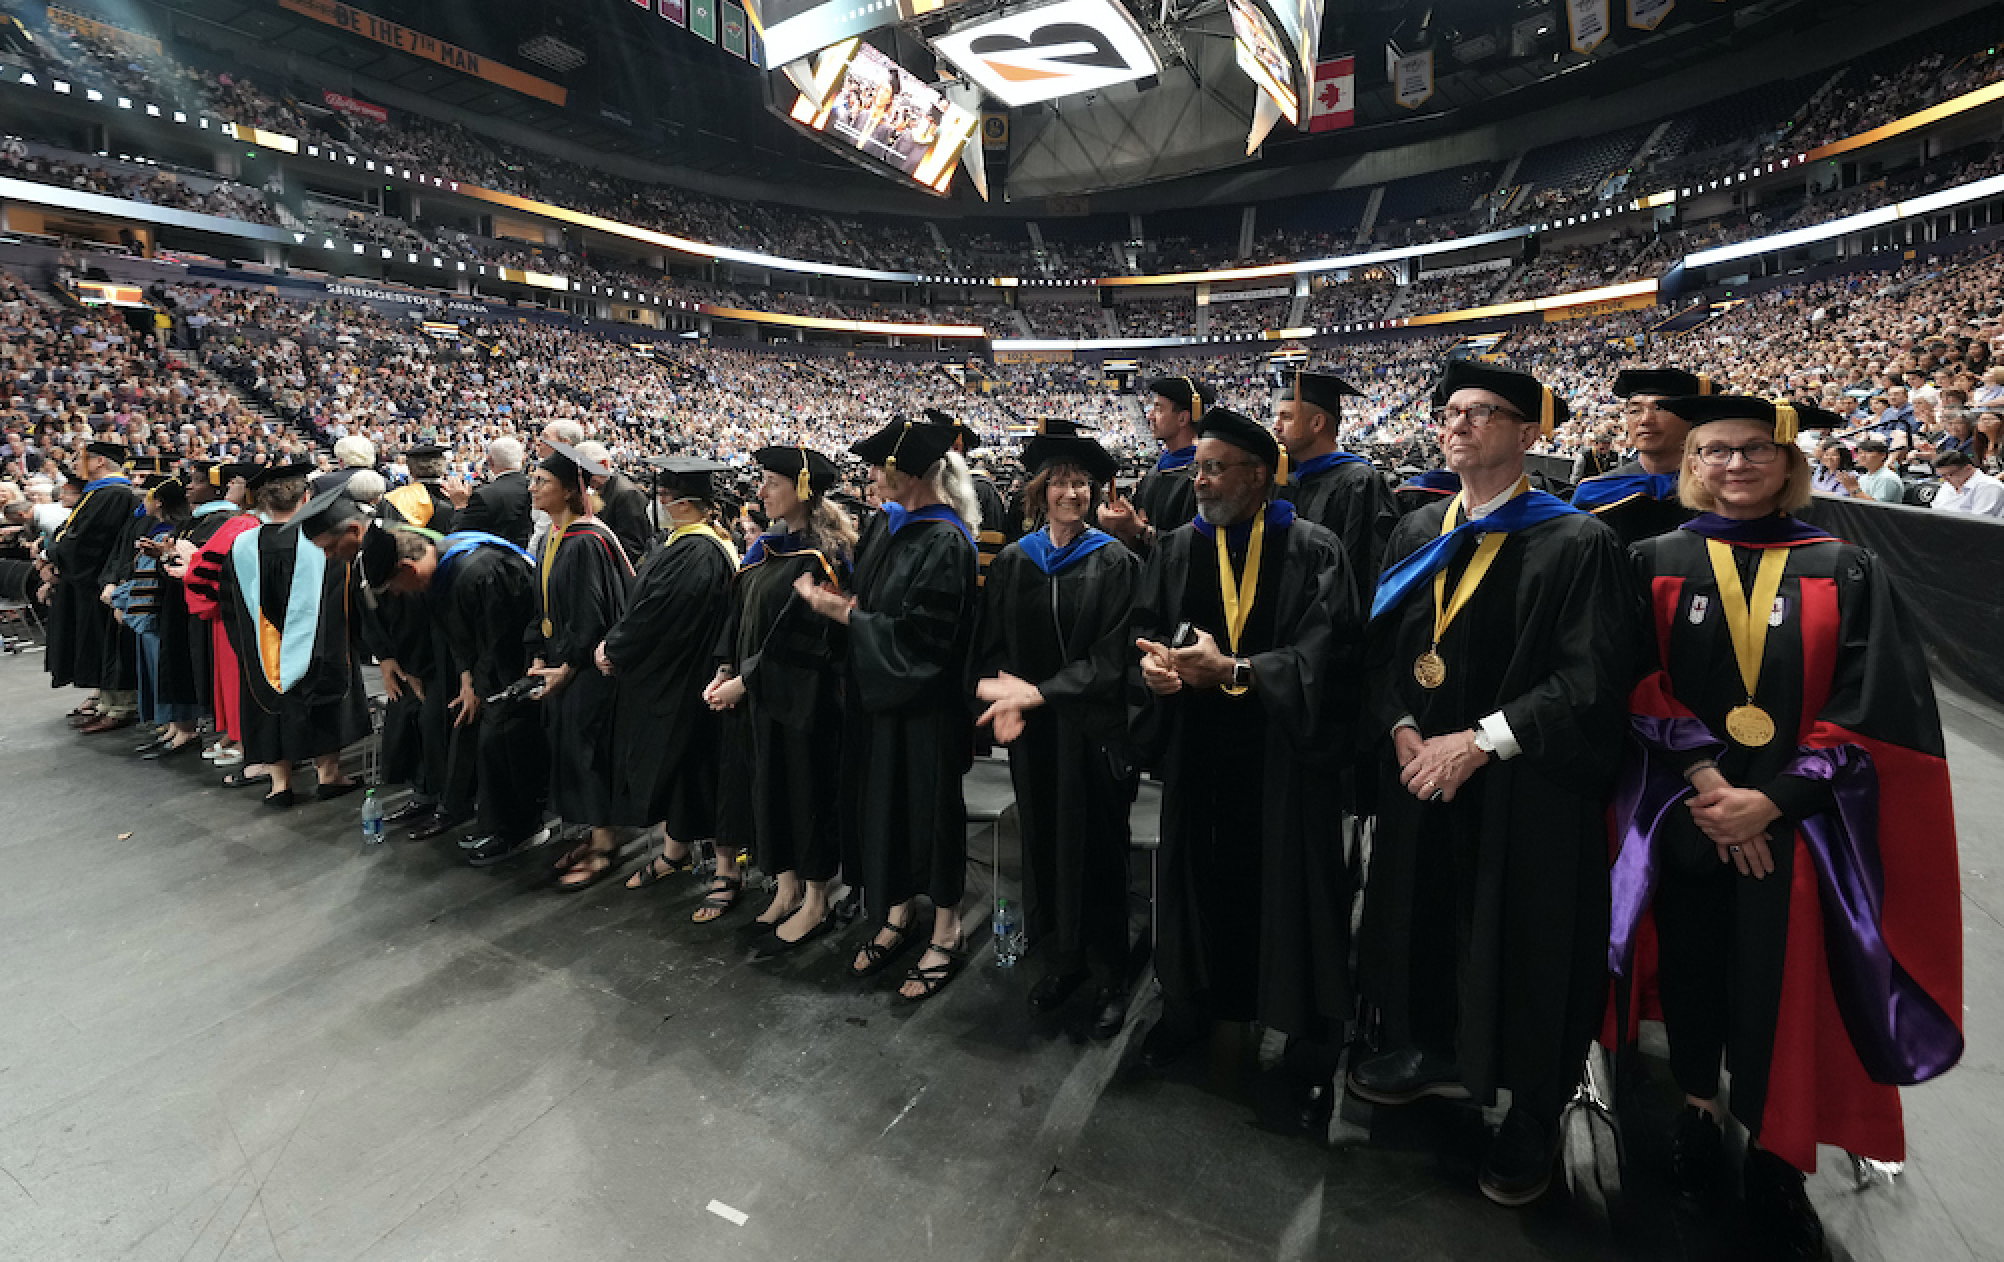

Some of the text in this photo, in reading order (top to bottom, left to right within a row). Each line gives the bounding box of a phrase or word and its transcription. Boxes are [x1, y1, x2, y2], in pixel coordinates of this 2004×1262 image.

[335, 4, 479, 73] BE THE 7TH MAN
